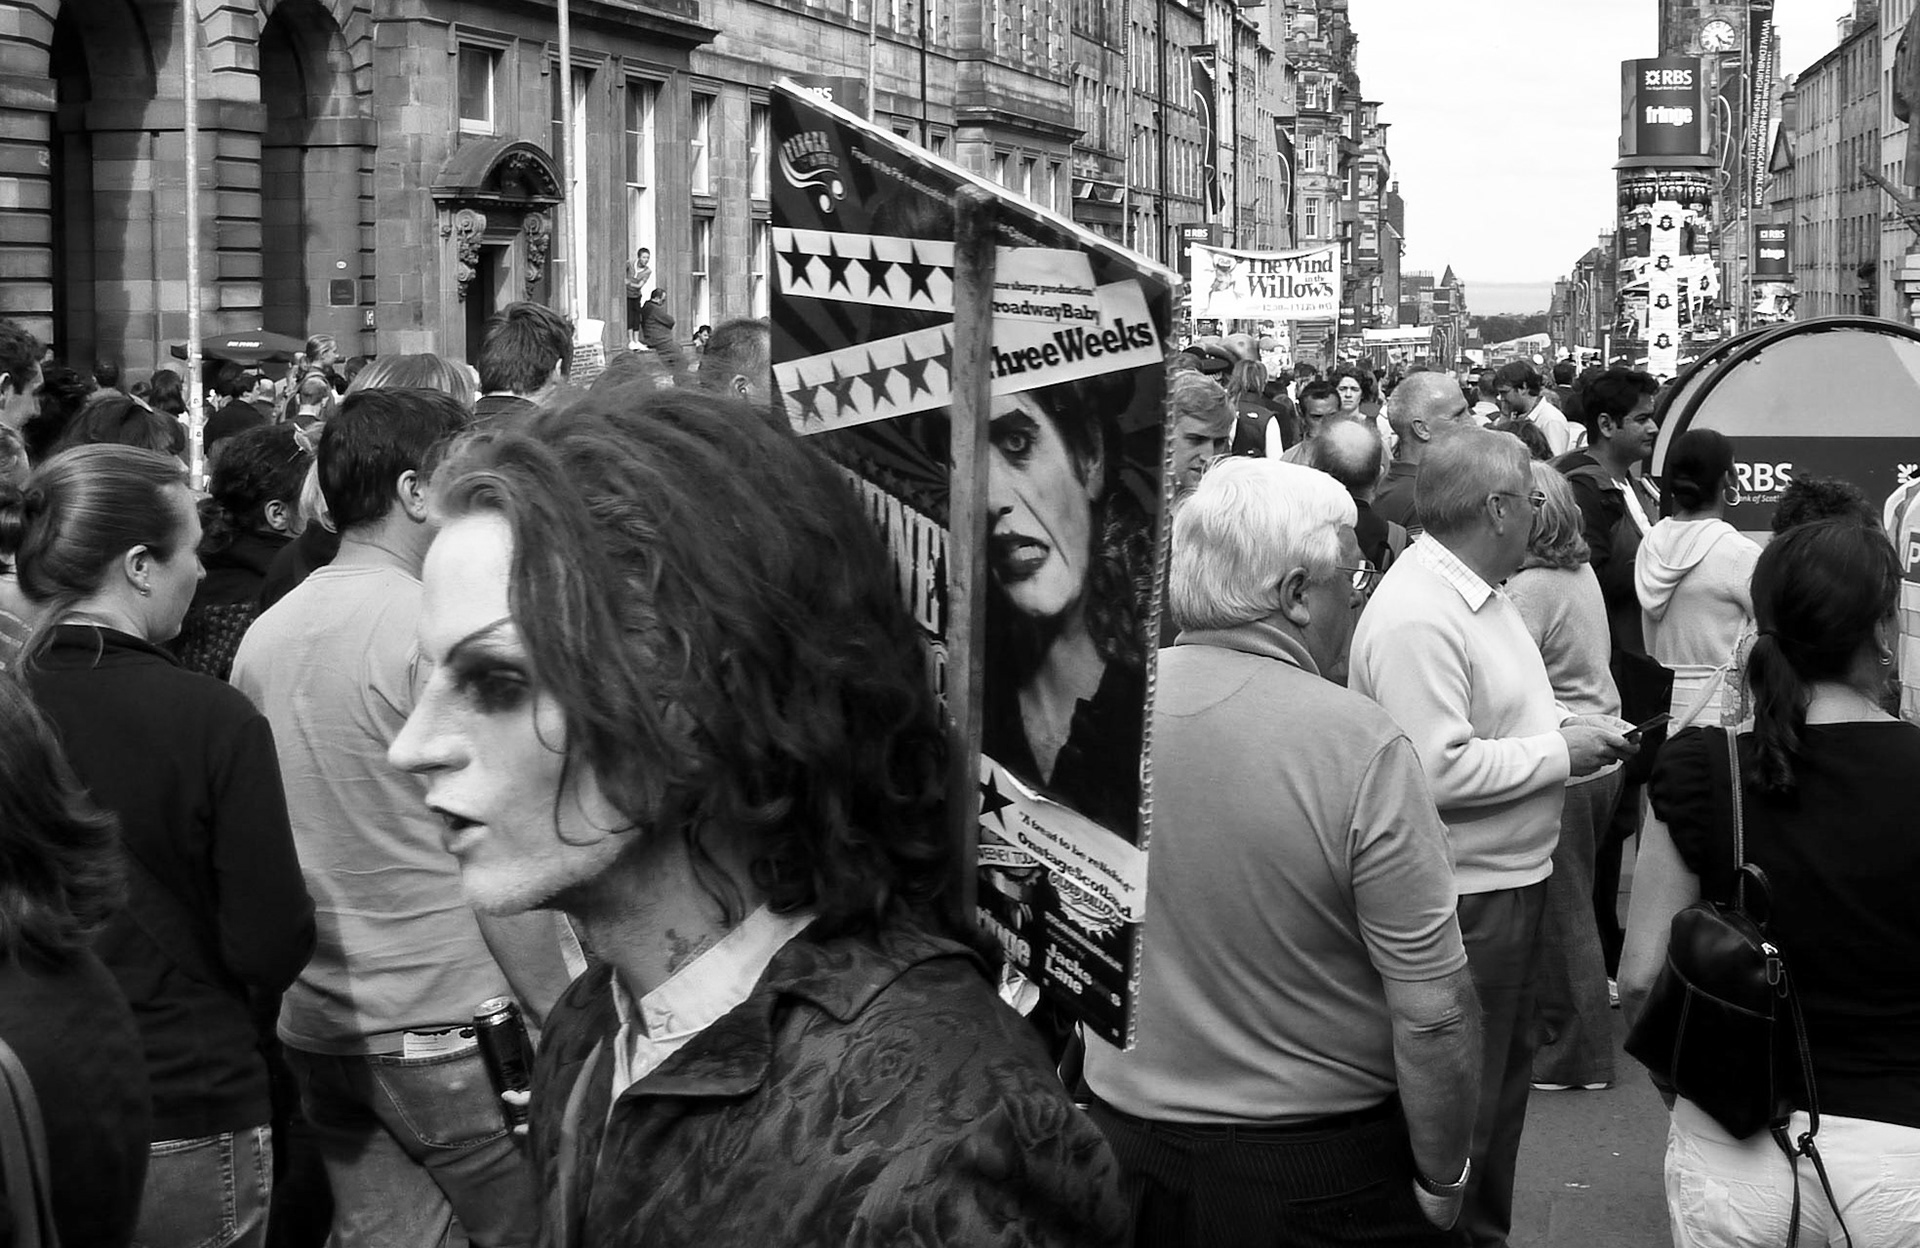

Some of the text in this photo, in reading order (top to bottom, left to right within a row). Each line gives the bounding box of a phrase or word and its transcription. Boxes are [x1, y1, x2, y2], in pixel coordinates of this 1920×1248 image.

[1661, 69, 1693, 86] RBS
[1645, 105, 1693, 127] fringe
[1248, 251, 1334, 274] The Wind
[1246, 274, 1334, 299] Willows
[991, 300, 1100, 326] roadwayBaby
[990, 317, 1155, 380] hreeWeeks
[1733, 462, 1793, 492] RBS
[1044, 955, 1084, 996] Lane
